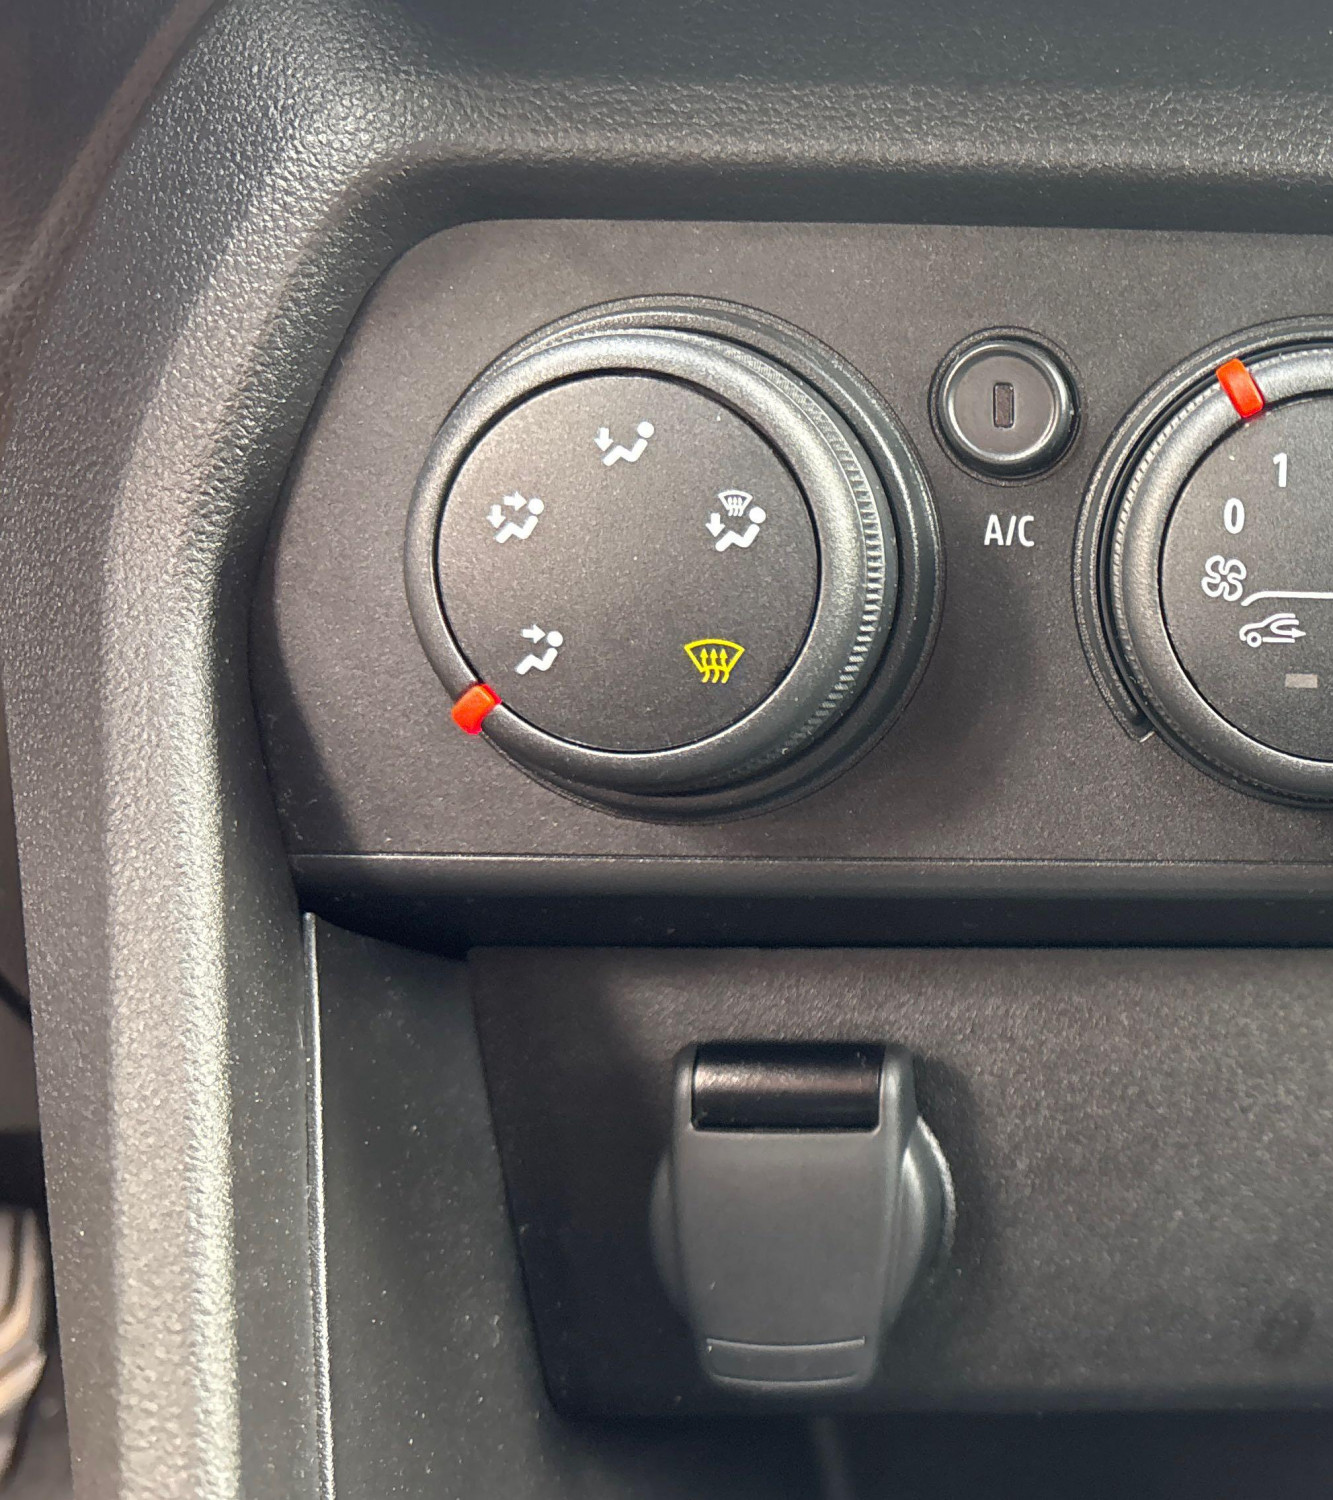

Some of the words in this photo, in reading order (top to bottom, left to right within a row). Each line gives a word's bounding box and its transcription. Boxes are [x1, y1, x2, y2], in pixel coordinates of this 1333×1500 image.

[1223, 497, 1245, 535] 0
[1272, 452, 1288, 488] 1
[983, 513, 1035, 548] A/C
